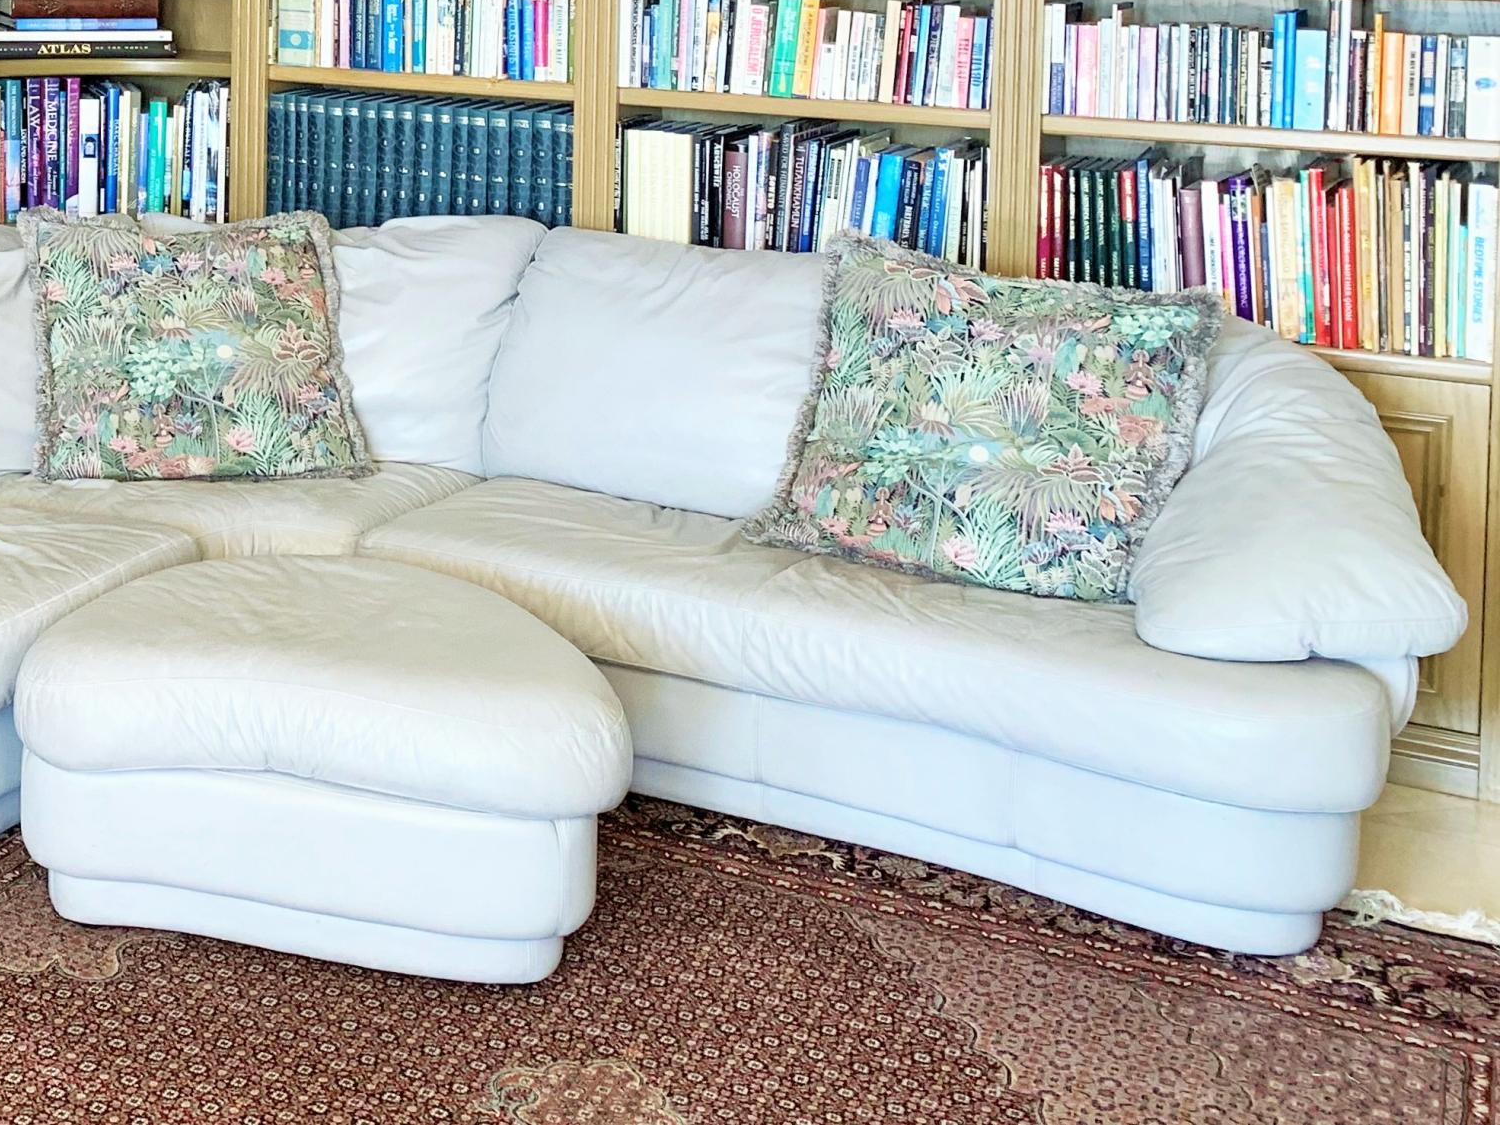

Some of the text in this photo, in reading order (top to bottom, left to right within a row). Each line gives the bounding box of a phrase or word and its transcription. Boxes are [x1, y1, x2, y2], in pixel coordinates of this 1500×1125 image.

[37, 43, 91, 55] ATLAS
[29, 95, 39, 128] LAW
[47, 101, 58, 161] MEDICINE
[731, 165, 741, 218] HOLOCAUST
[790, 156, 805, 228] TUTANKHAMUN
[1473, 237, 1485, 324] BEDTIME STORIES
